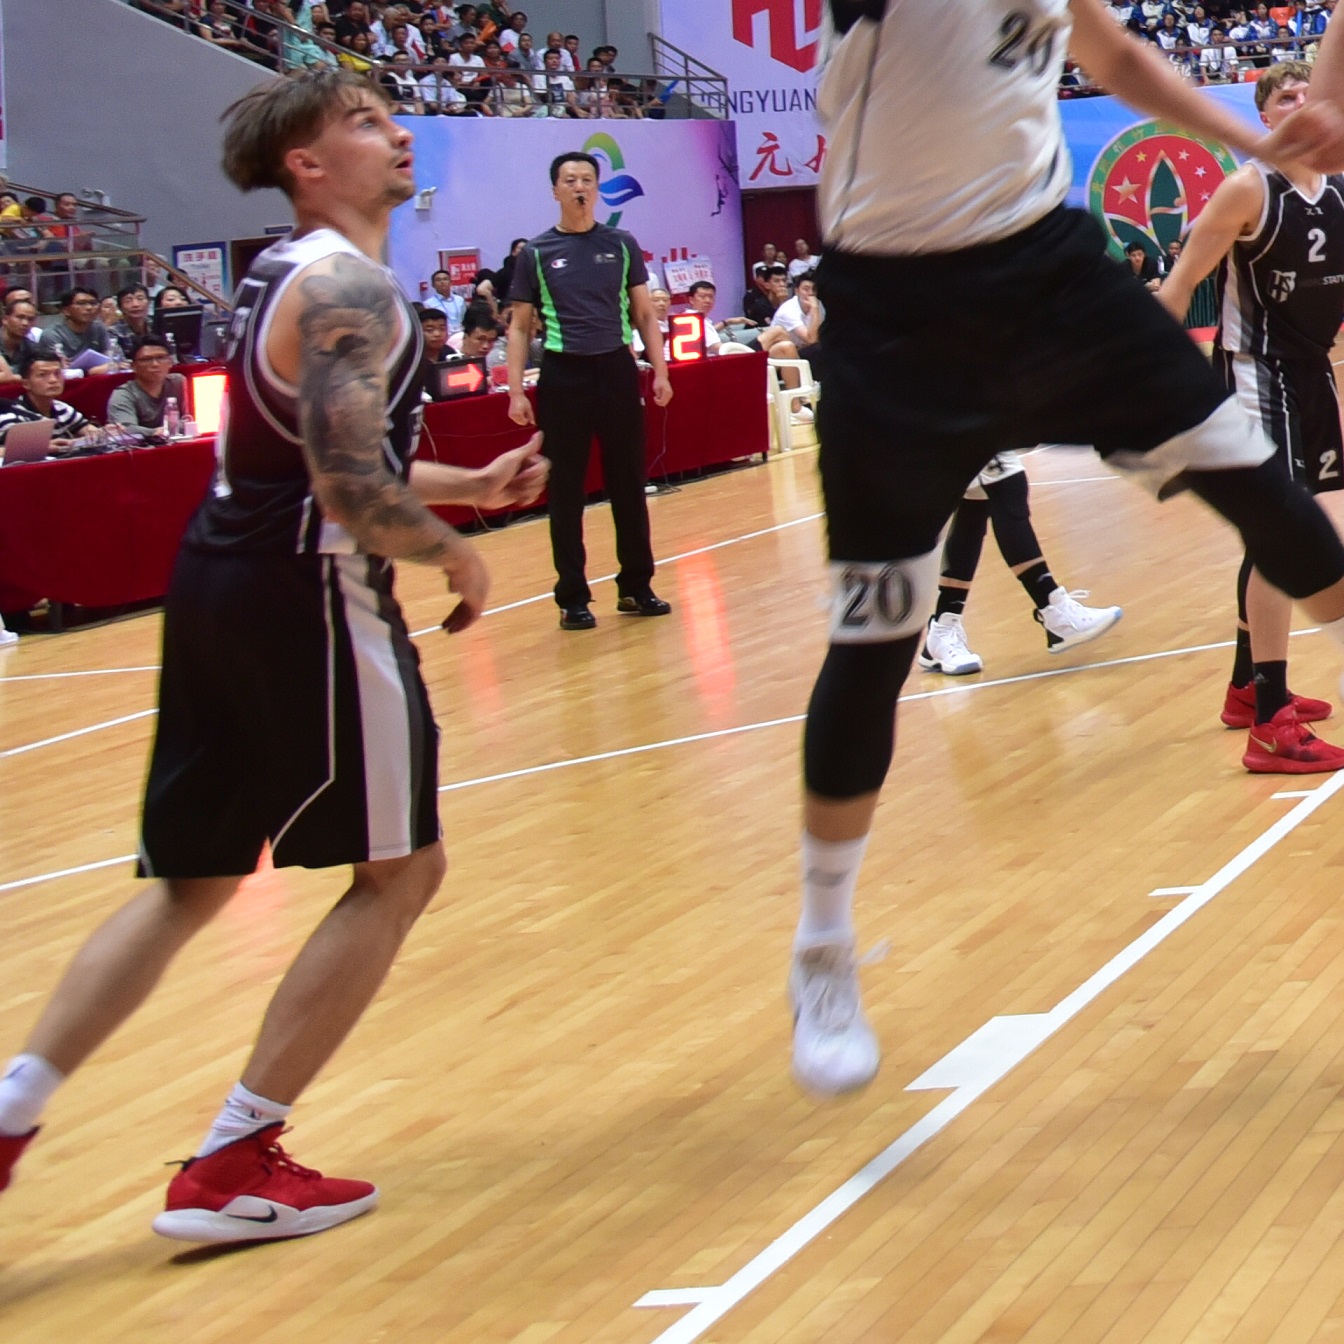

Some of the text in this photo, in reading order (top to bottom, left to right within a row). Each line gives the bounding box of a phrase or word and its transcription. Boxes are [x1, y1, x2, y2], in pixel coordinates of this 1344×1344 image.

[988, 11, 1058, 76] 20
[1307, 228, 1327, 263] 2
[673, 316, 701, 361] 2
[1318, 450, 1339, 481] 2
[841, 563, 914, 626] 20
